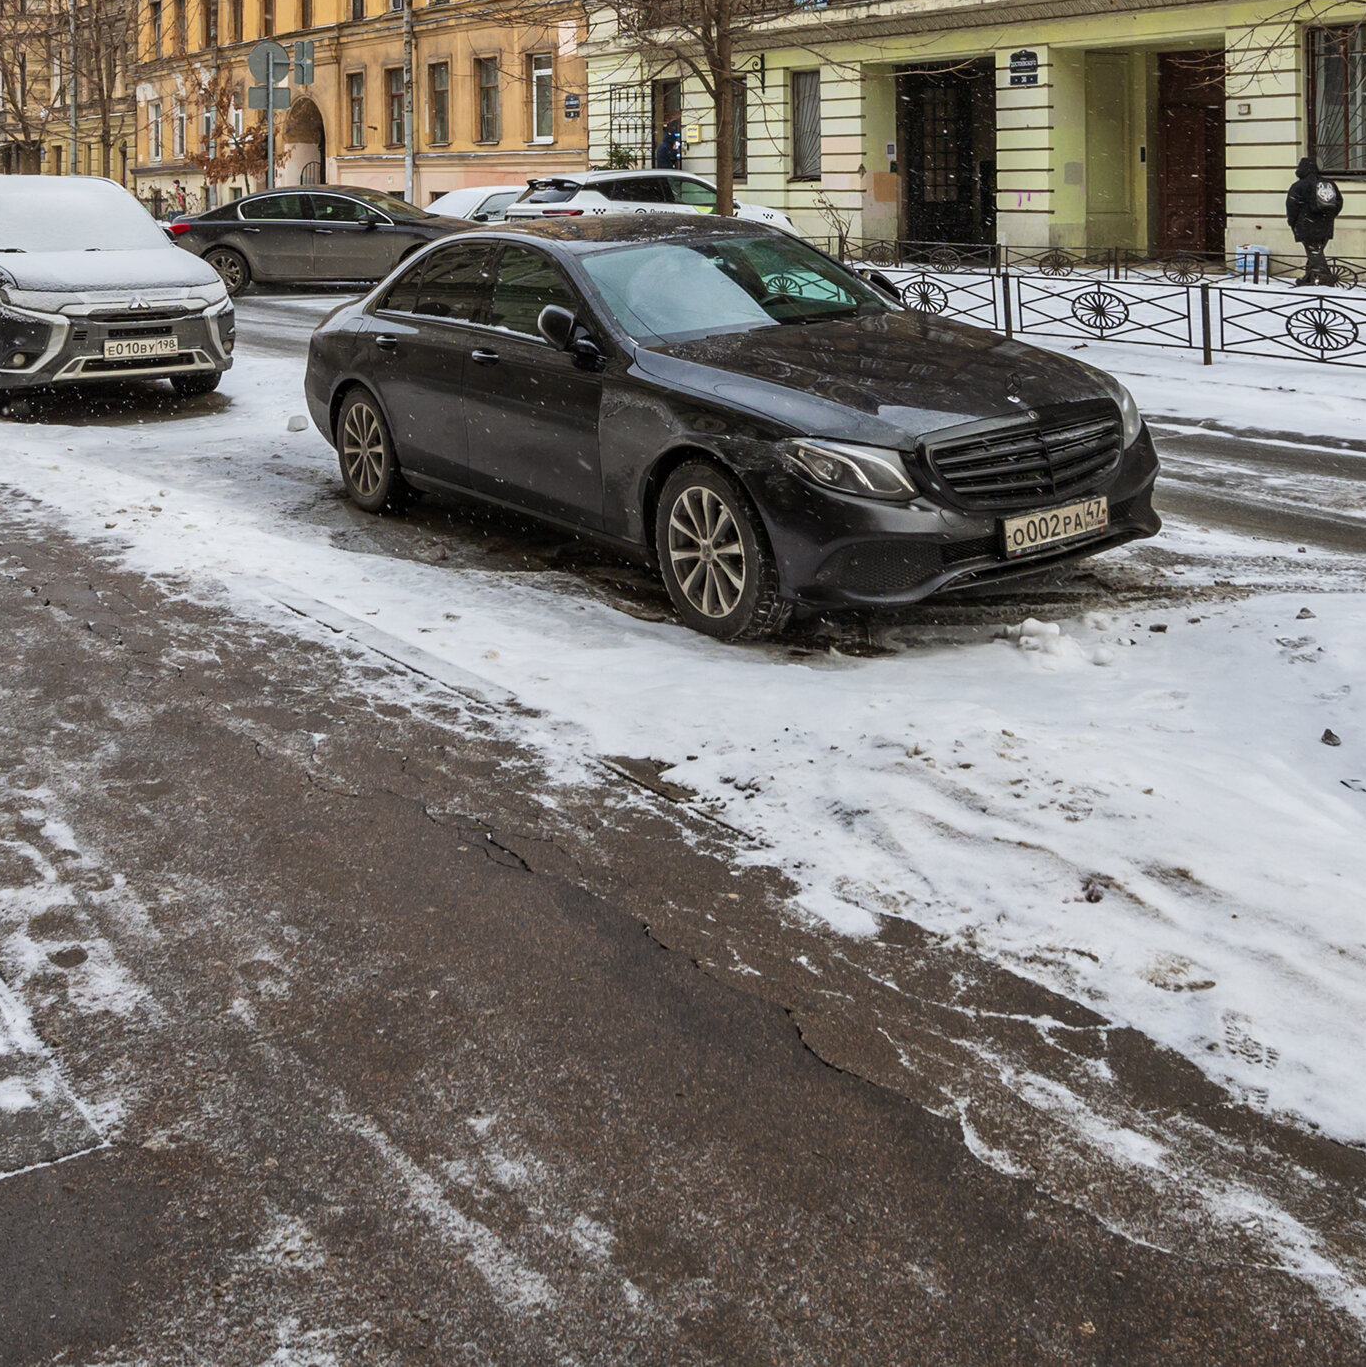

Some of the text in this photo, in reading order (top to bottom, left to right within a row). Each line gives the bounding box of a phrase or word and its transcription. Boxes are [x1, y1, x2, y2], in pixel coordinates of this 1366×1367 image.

[108, 339, 175, 356] Е010ВУ 198
[1013, 512, 1084, 546] О002РА
[1086, 500, 1101, 520] 47
